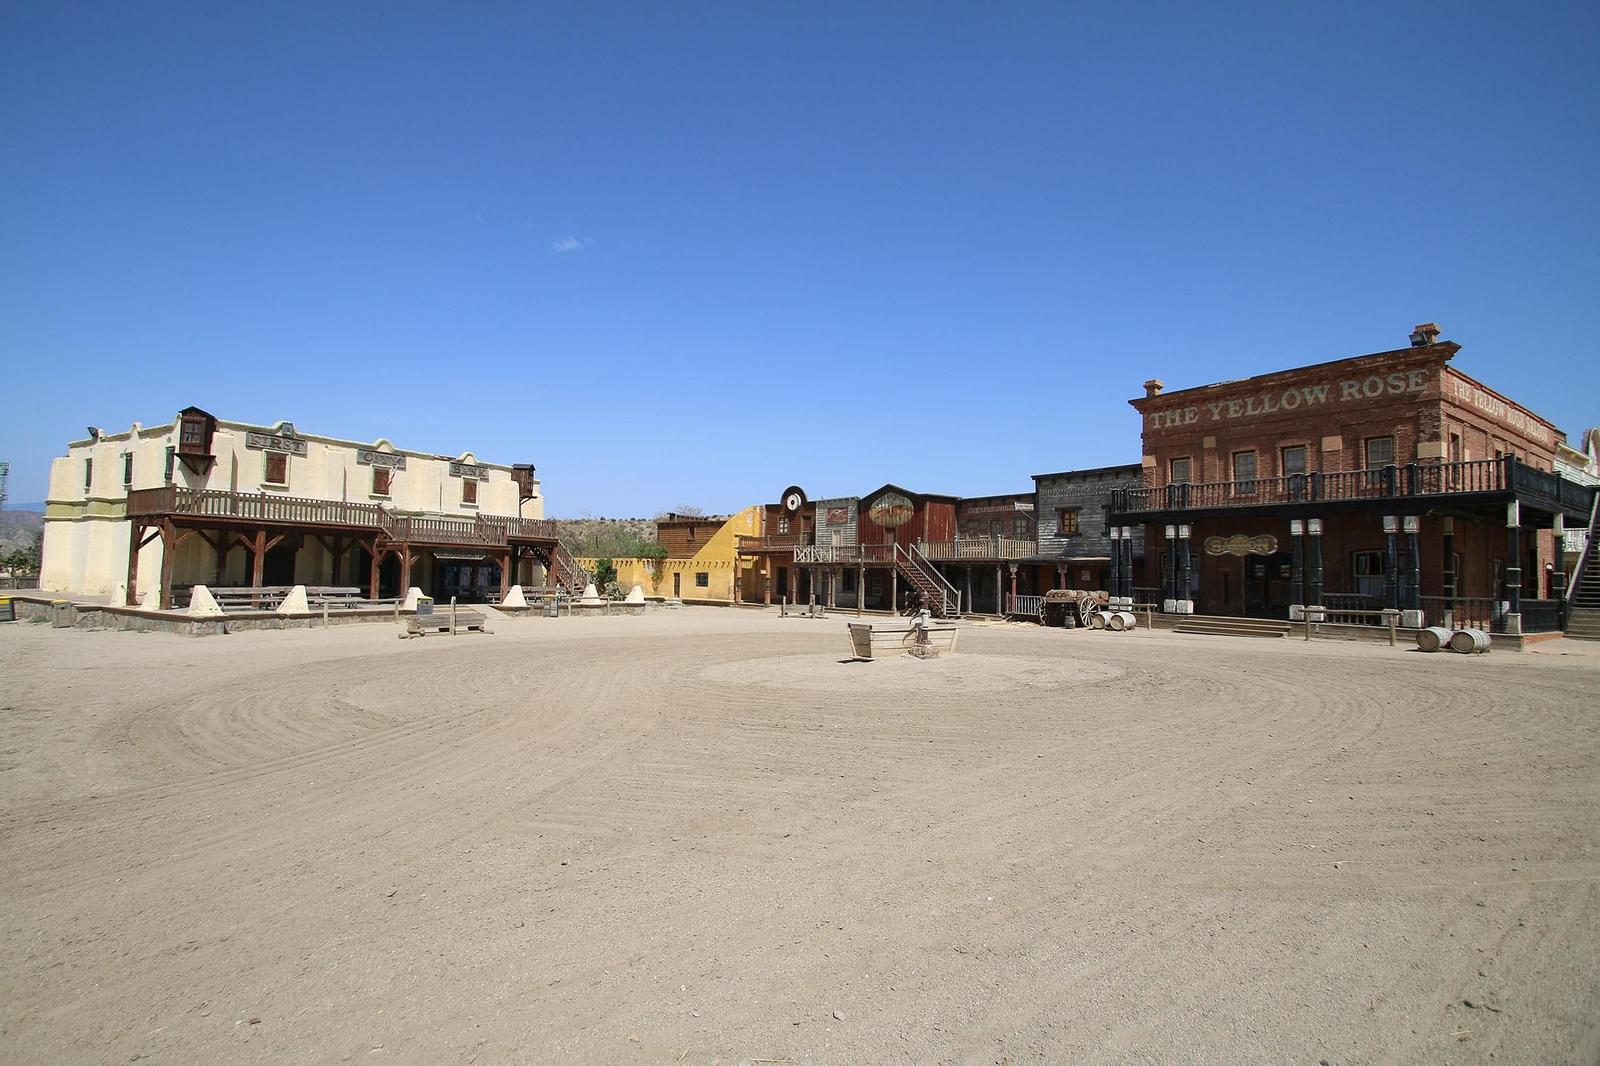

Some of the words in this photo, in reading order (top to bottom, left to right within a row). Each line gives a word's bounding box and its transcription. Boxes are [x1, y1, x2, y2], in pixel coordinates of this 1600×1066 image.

[1150, 407, 1199, 429] THE
[1201, 381, 1331, 421] YELLOW
[1339, 368, 1432, 402] ROSE
[1453, 376, 1472, 402] THE
[1473, 388, 1506, 419] YELLOW
[1506, 404, 1525, 430] ROSE
[249, 434, 304, 452] FIRST
[363, 452, 401, 466] CITY
[452, 465, 488, 479] BANK
